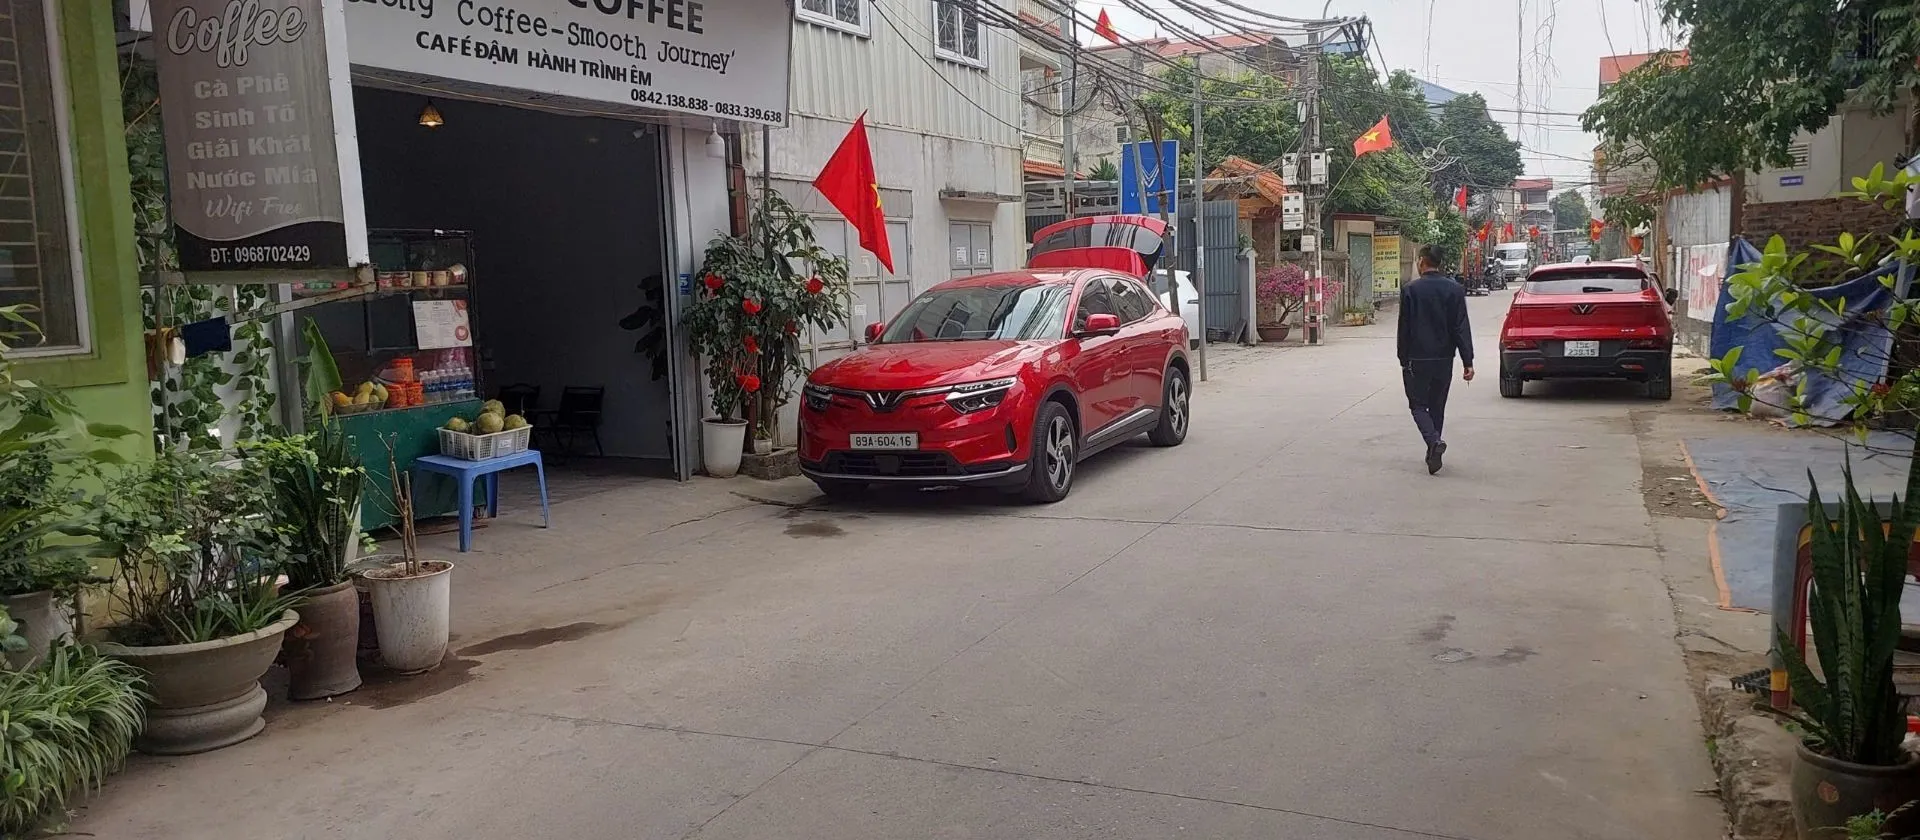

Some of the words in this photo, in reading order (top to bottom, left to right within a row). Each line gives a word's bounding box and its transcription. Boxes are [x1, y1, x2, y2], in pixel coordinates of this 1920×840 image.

[167, 0, 307, 68] Coffee
[528, 49, 576, 74] HÀNH
[580, 59, 627, 83] TRÌNH
[631, 65, 652, 87] ÊM
[194, 79, 229, 99] Cà
[236, 73, 289, 95] Phê
[195, 108, 255, 129] Sinh
[263, 101, 296, 124] Tố
[187, 138, 239, 160] Giải
[187, 168, 256, 189] Nước
[264, 165, 318, 185] Mía
[205, 194, 253, 224] Wifi
[259, 196, 303, 215] Free
[210, 247, 232, 263] ĐT:
[234, 245, 311, 262] 0968702429
[855, 435, 912, 447] 89A-604.16
